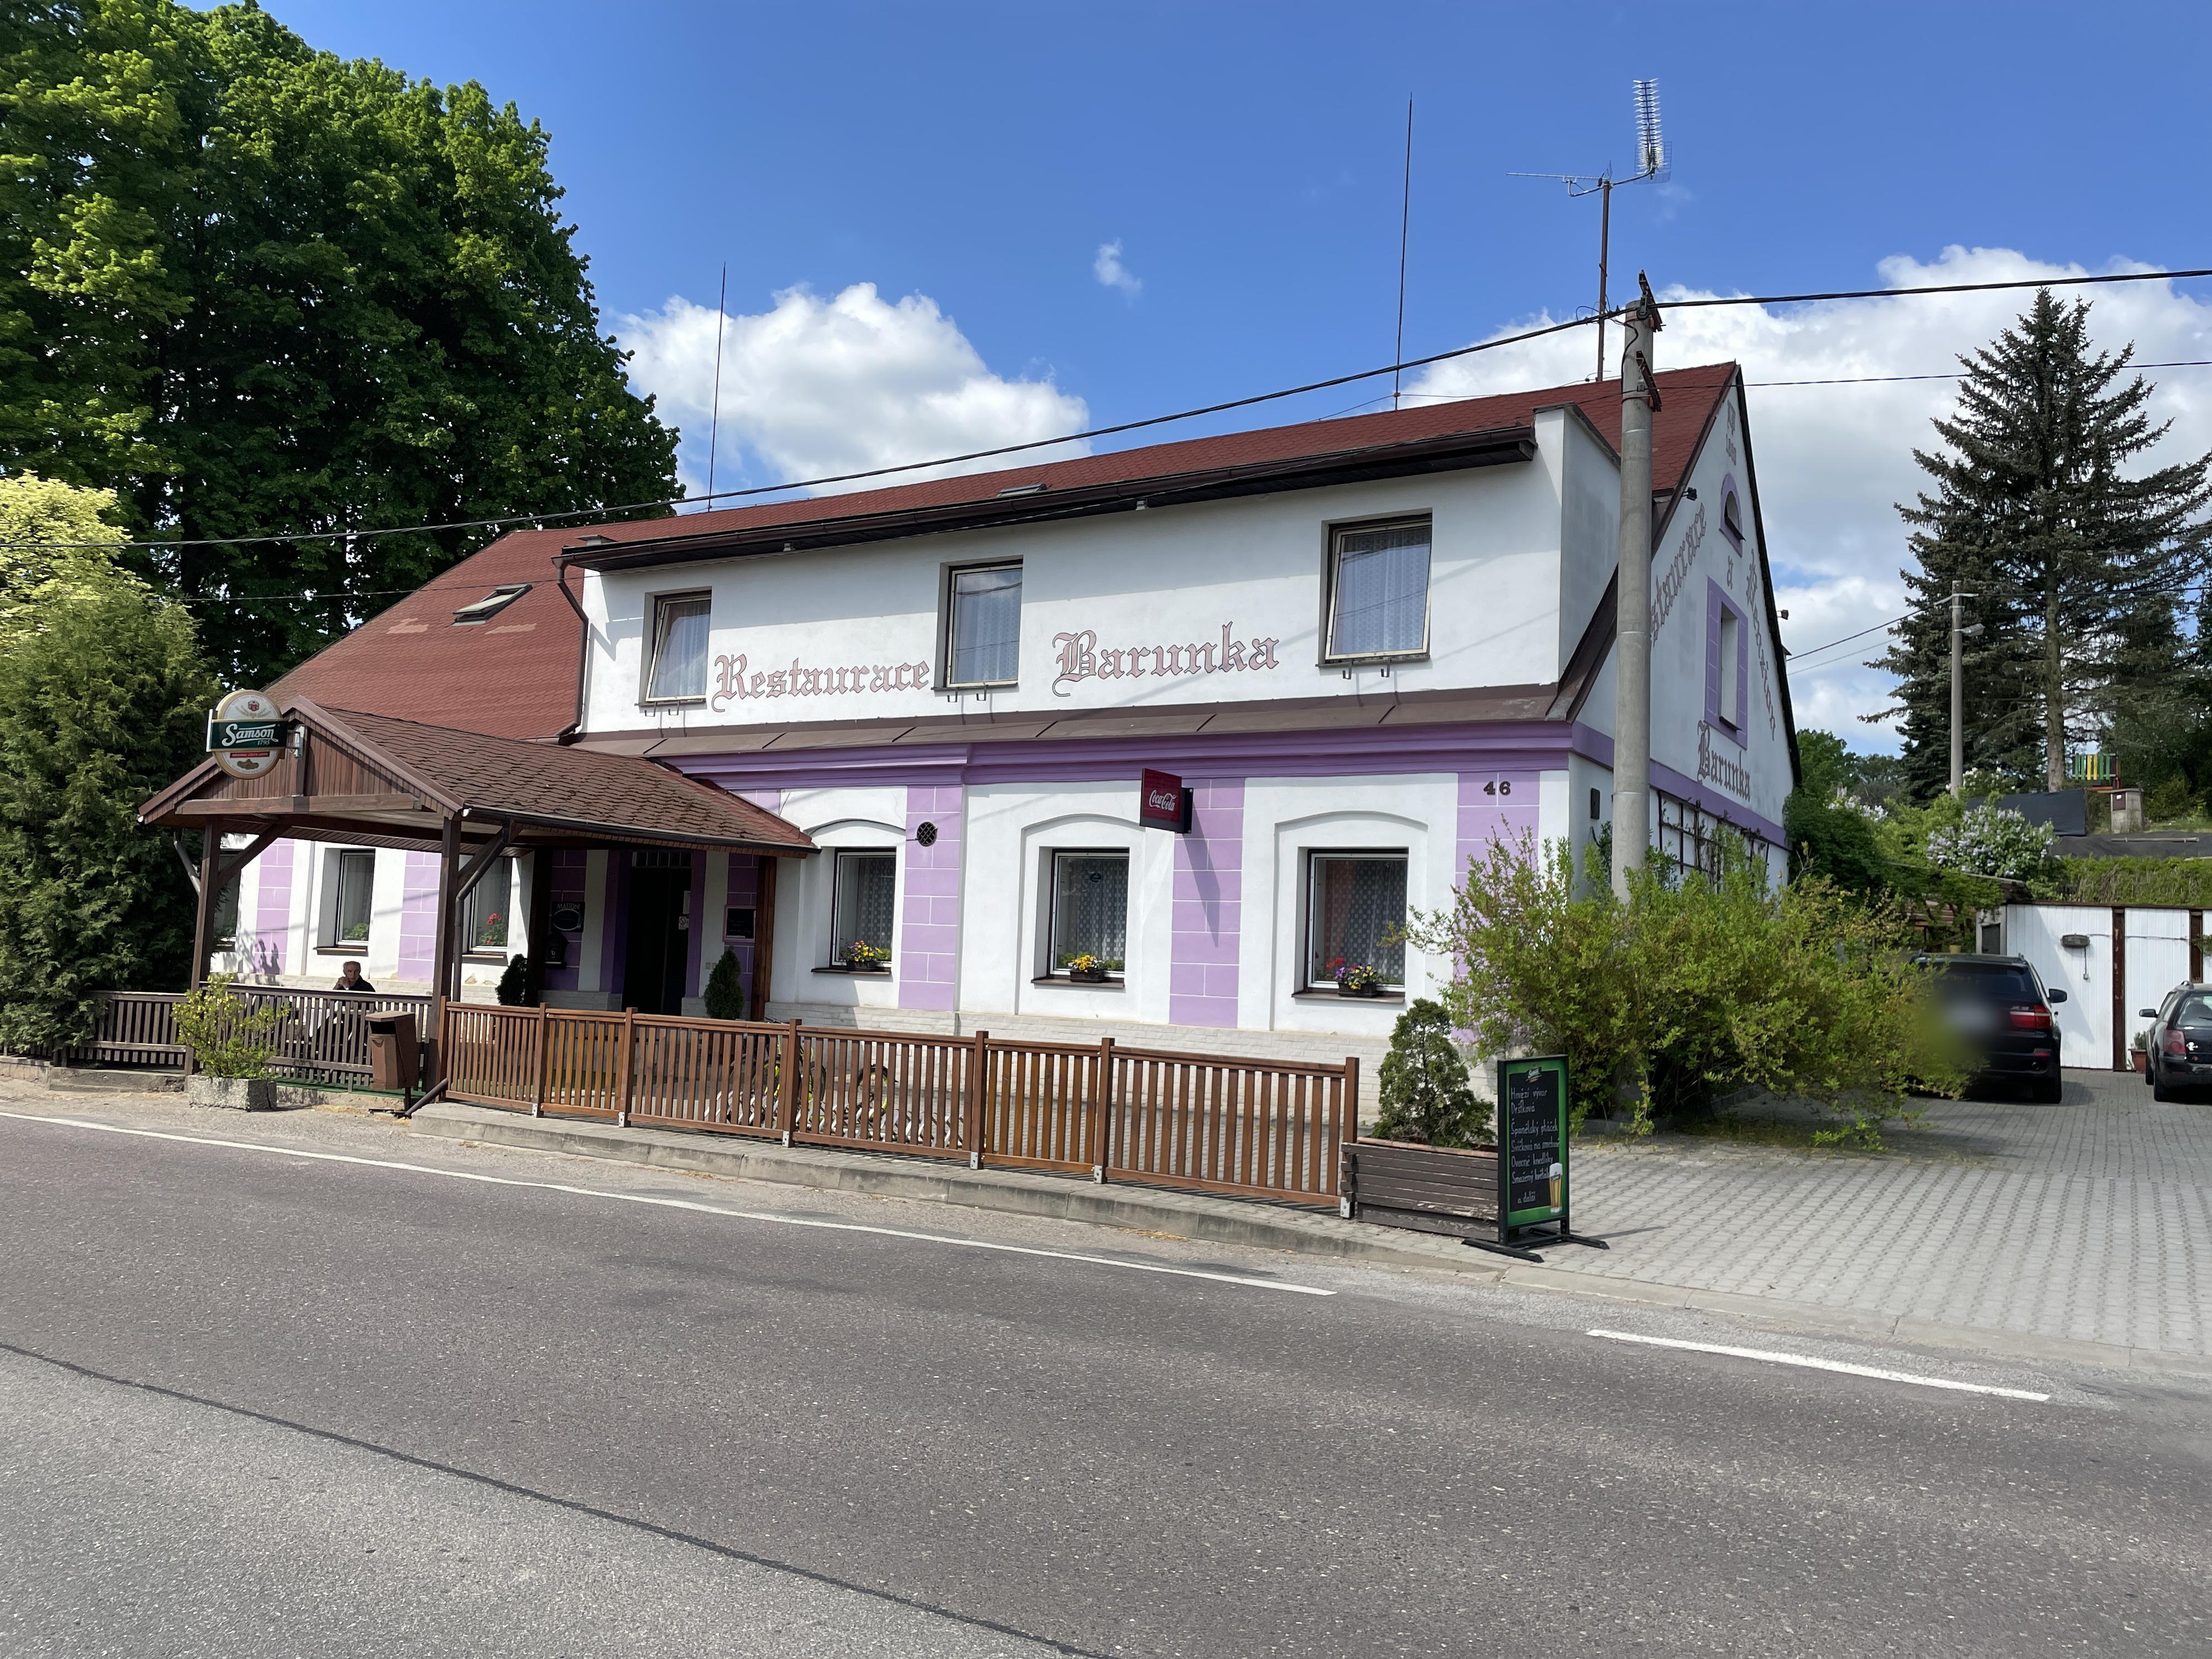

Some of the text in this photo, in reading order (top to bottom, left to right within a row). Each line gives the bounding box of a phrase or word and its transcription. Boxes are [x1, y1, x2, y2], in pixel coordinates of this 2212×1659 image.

[711, 620, 1280, 713] Restaurace Barunka
[222, 723, 278, 746] Samson
[1697, 720, 1751, 802] Barunka
[1483, 781, 1511, 795] 46
[1511, 1087, 1529, 1099] Hovězí
[1511, 1118, 1558, 1137] Španělský ptáček
[1523, 1191, 1536, 1203] další
